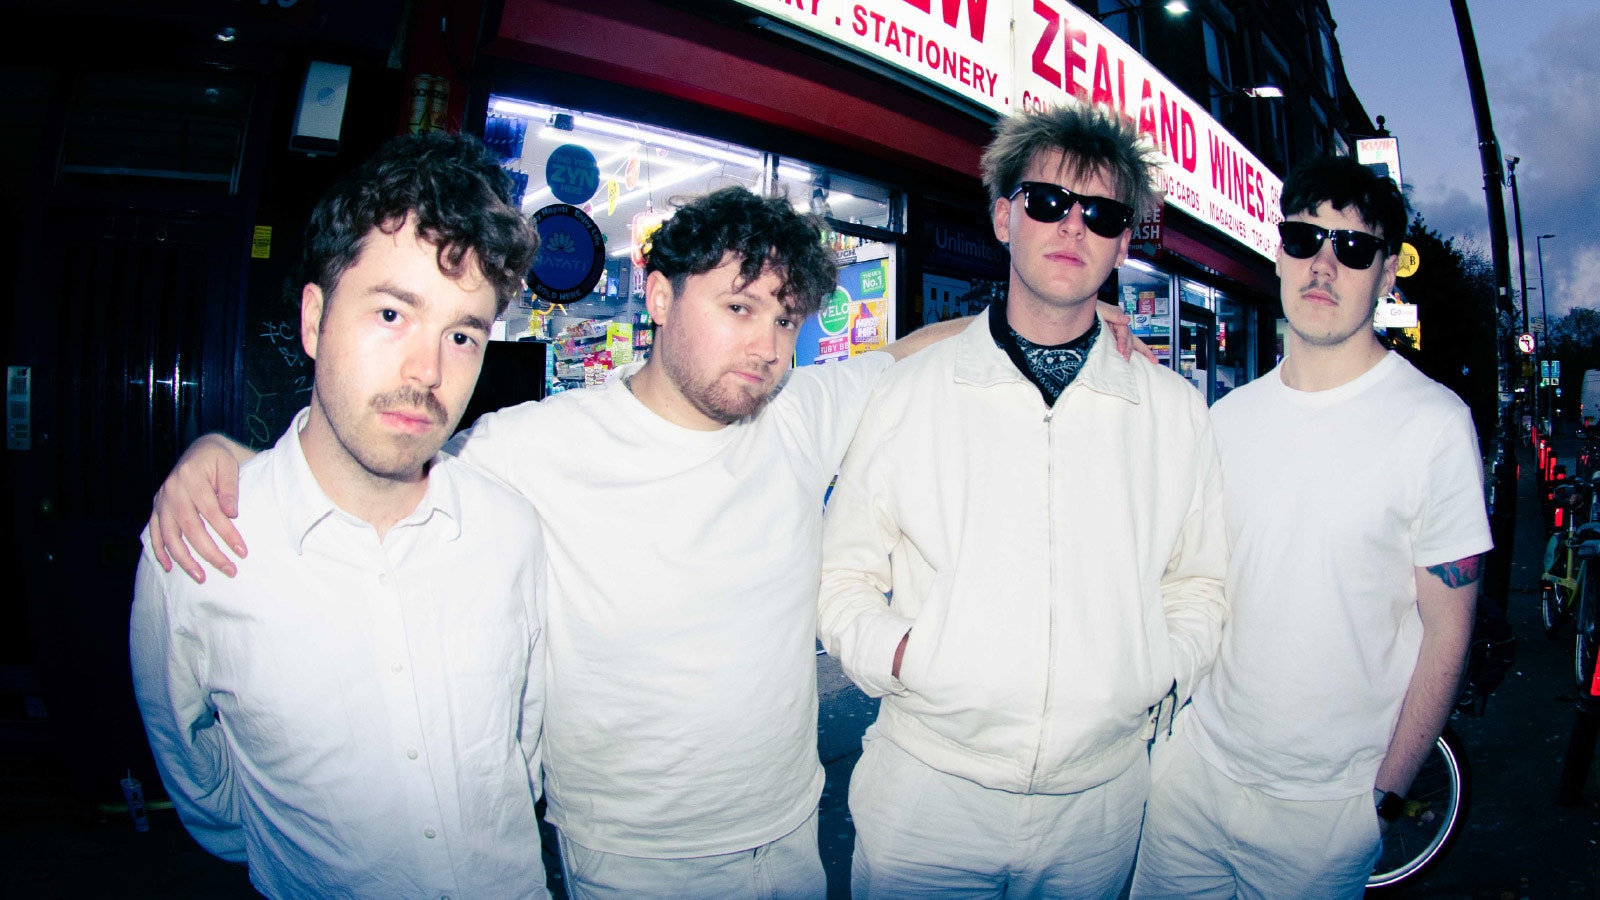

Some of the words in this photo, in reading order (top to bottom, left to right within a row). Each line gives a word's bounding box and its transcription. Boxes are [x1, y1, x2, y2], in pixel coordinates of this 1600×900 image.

[1031, 0, 1197, 174] ZEALAND
[1208, 128, 1265, 223] WINES
[852, 4, 998, 98] STATIONERY
[1176, 180, 1200, 212] CARDS
[1209, 200, 1247, 239] MAGAZINES
[1360, 140, 1396, 152] KWIK
[551, 163, 595, 188] ZYN
[560, 184, 584, 195] HERE
[1132, 224, 1161, 240] ASH
[1409, 255, 1416, 266] B
[535, 283, 558, 299] SOLD
[559, 289, 582, 301] HERE
[822, 302, 849, 319] VELO
